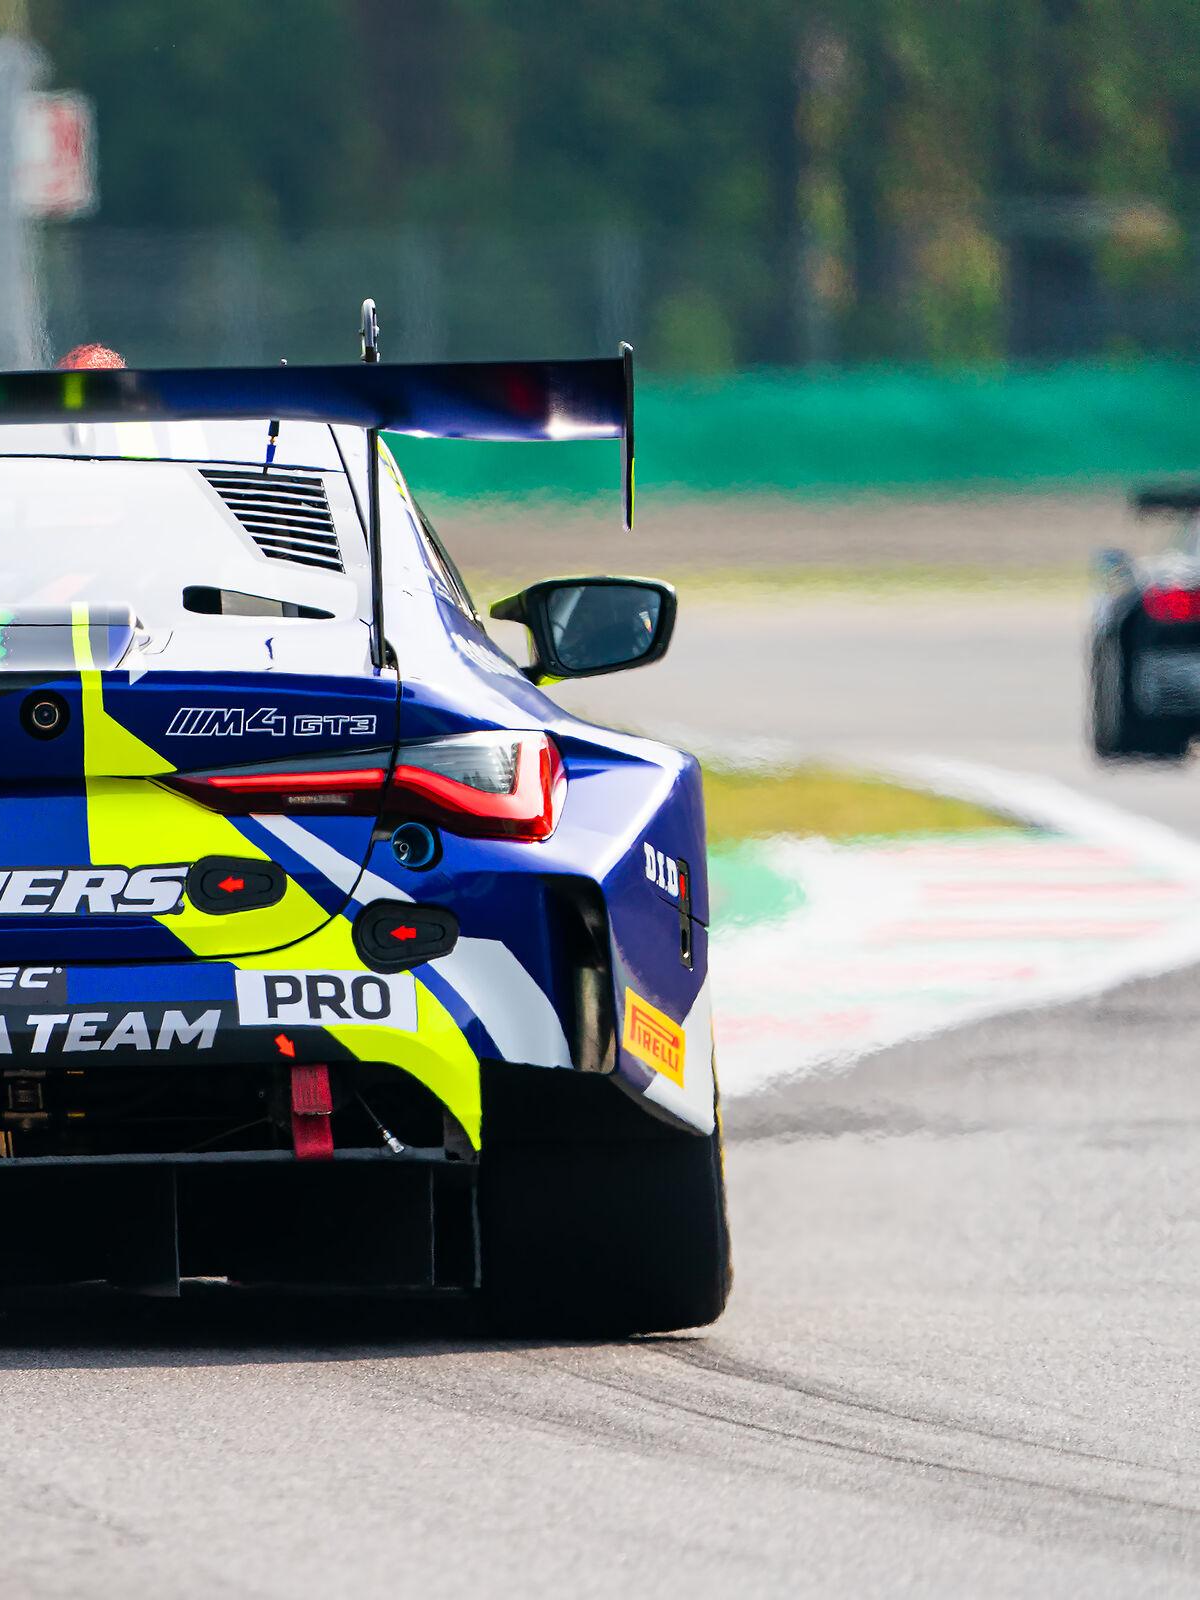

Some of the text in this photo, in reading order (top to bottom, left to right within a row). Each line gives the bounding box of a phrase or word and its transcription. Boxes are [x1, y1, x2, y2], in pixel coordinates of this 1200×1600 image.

[293, 715, 377, 736] GT3
[264, 974, 391, 1020] PRO
[25, 1008, 221, 1054] TEAM
[630, 1004, 680, 1072] PIRELLI
